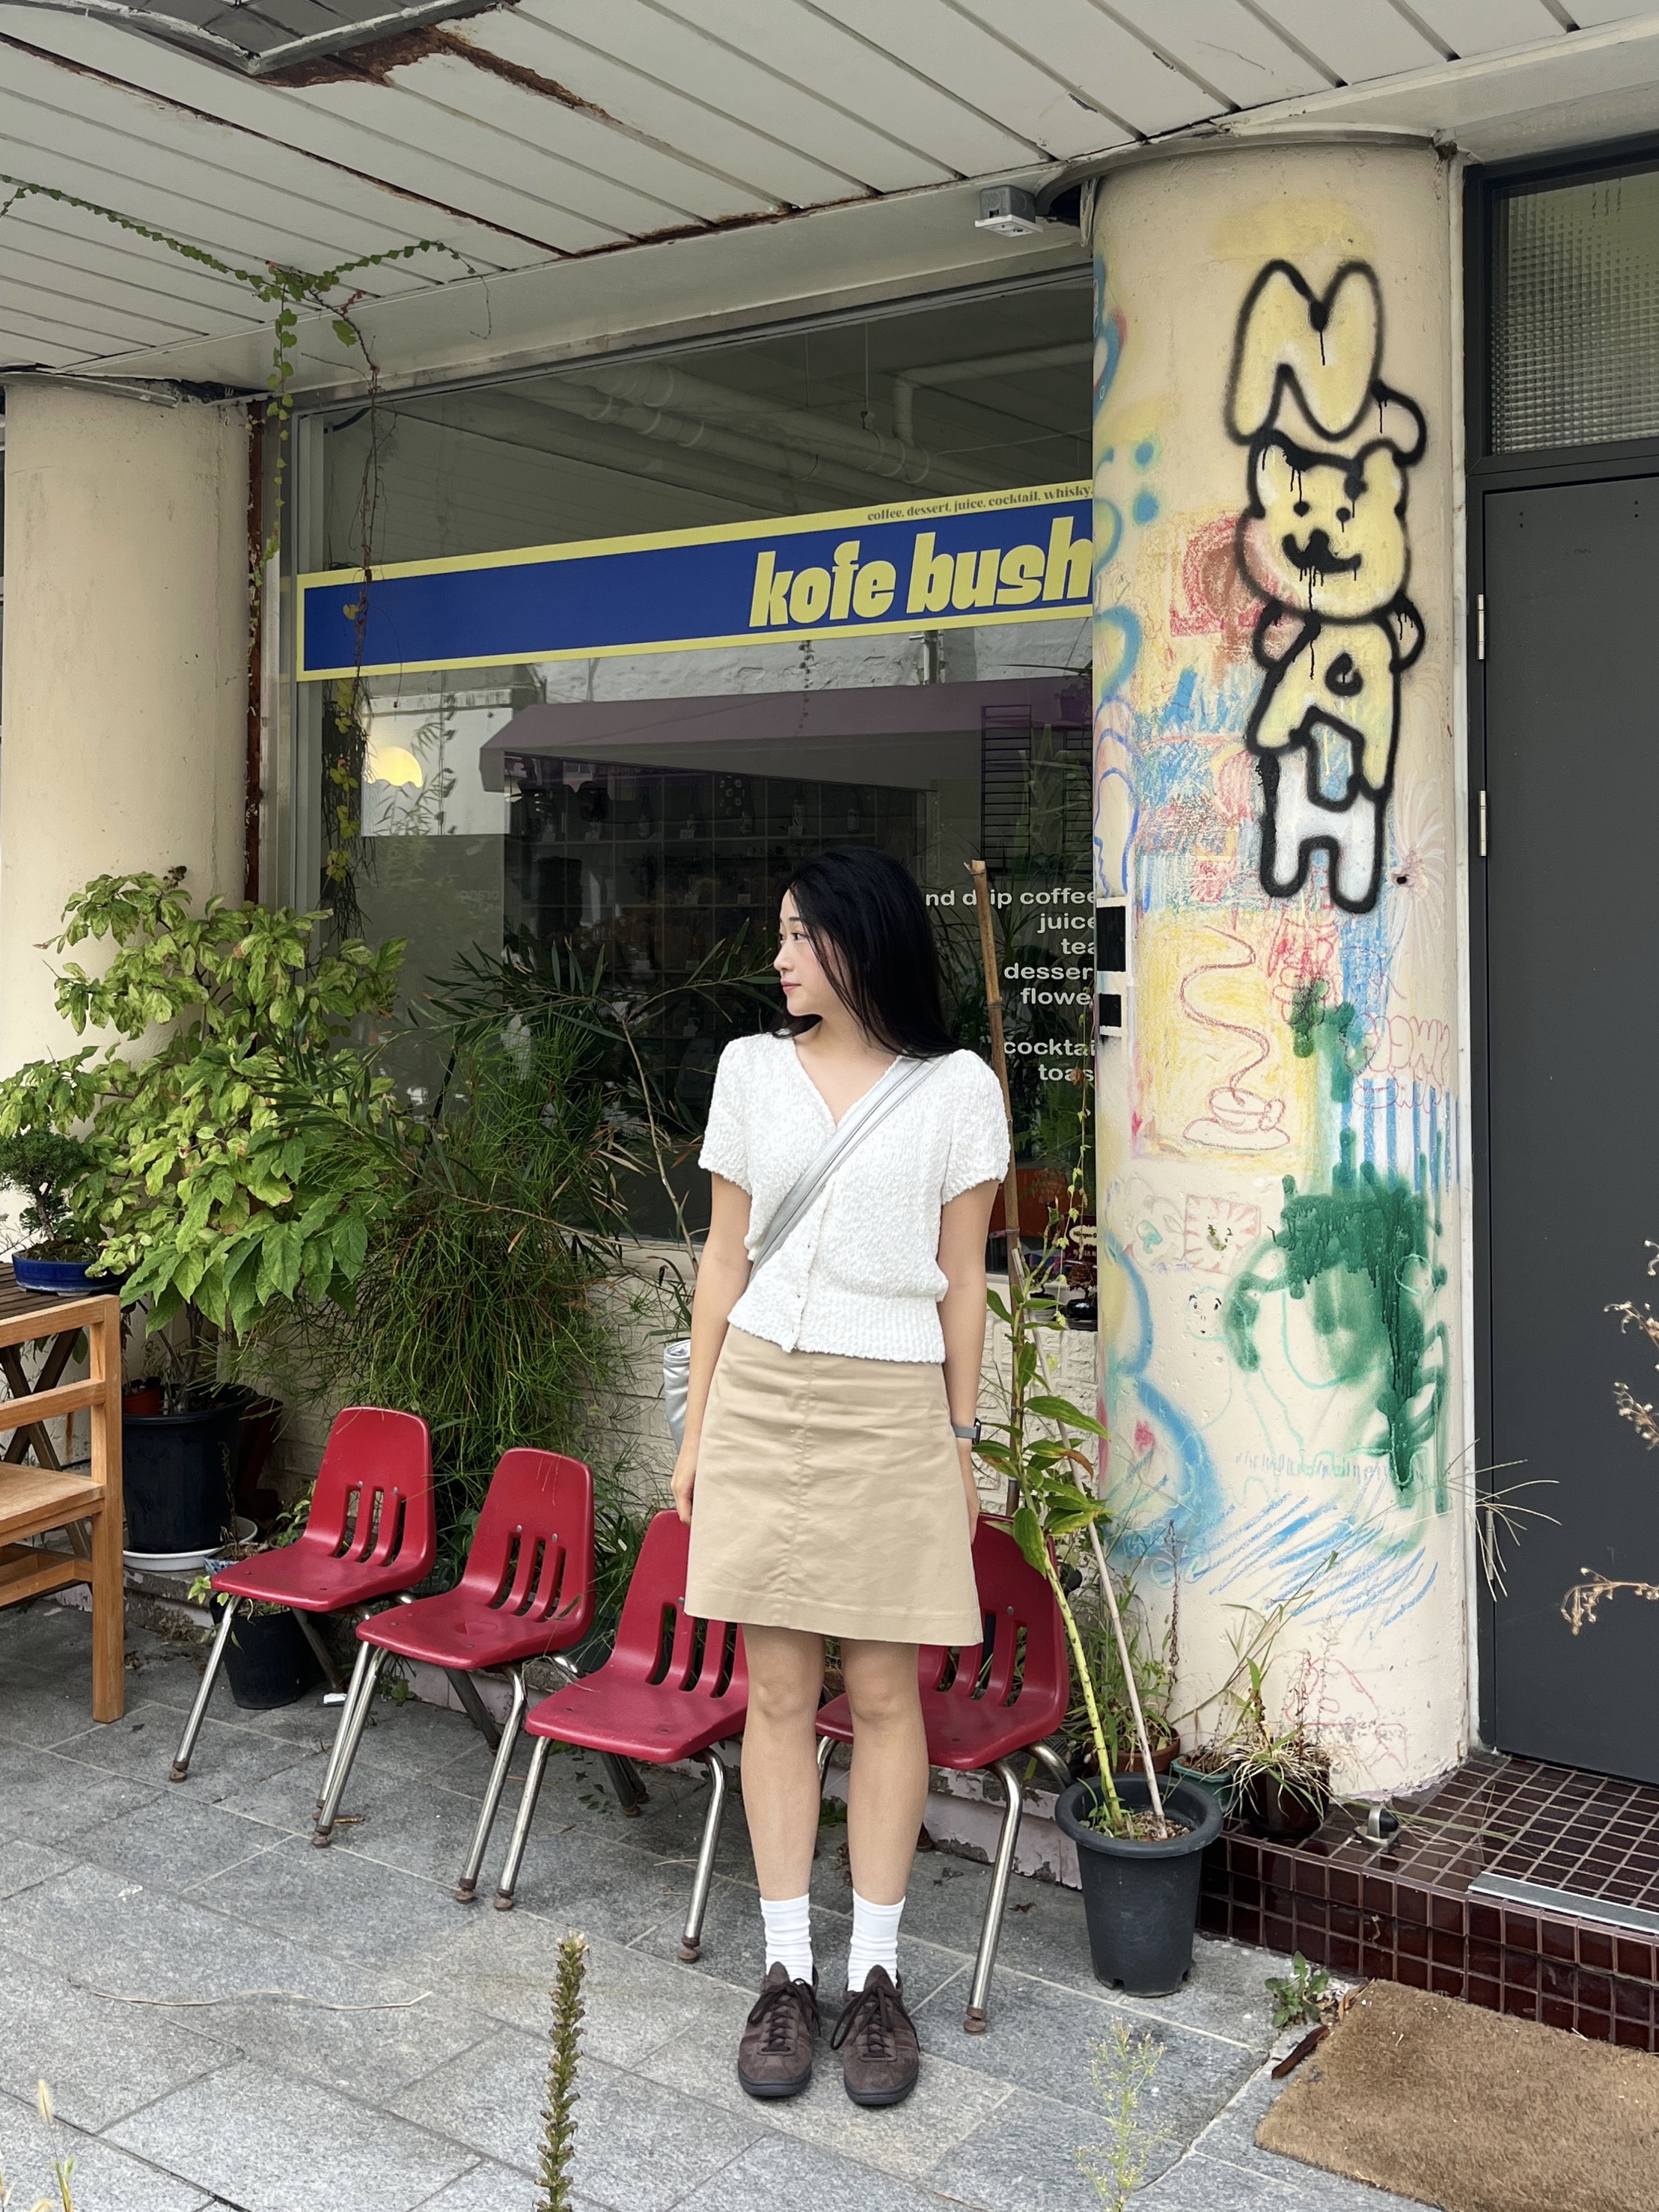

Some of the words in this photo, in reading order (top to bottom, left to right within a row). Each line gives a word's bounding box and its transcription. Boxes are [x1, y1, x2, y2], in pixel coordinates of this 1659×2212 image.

[749, 540, 897, 628] kofe
[905, 516, 1093, 614] bush
[962, 888, 1012, 909] dip
[1020, 987, 1094, 1005] flowe
